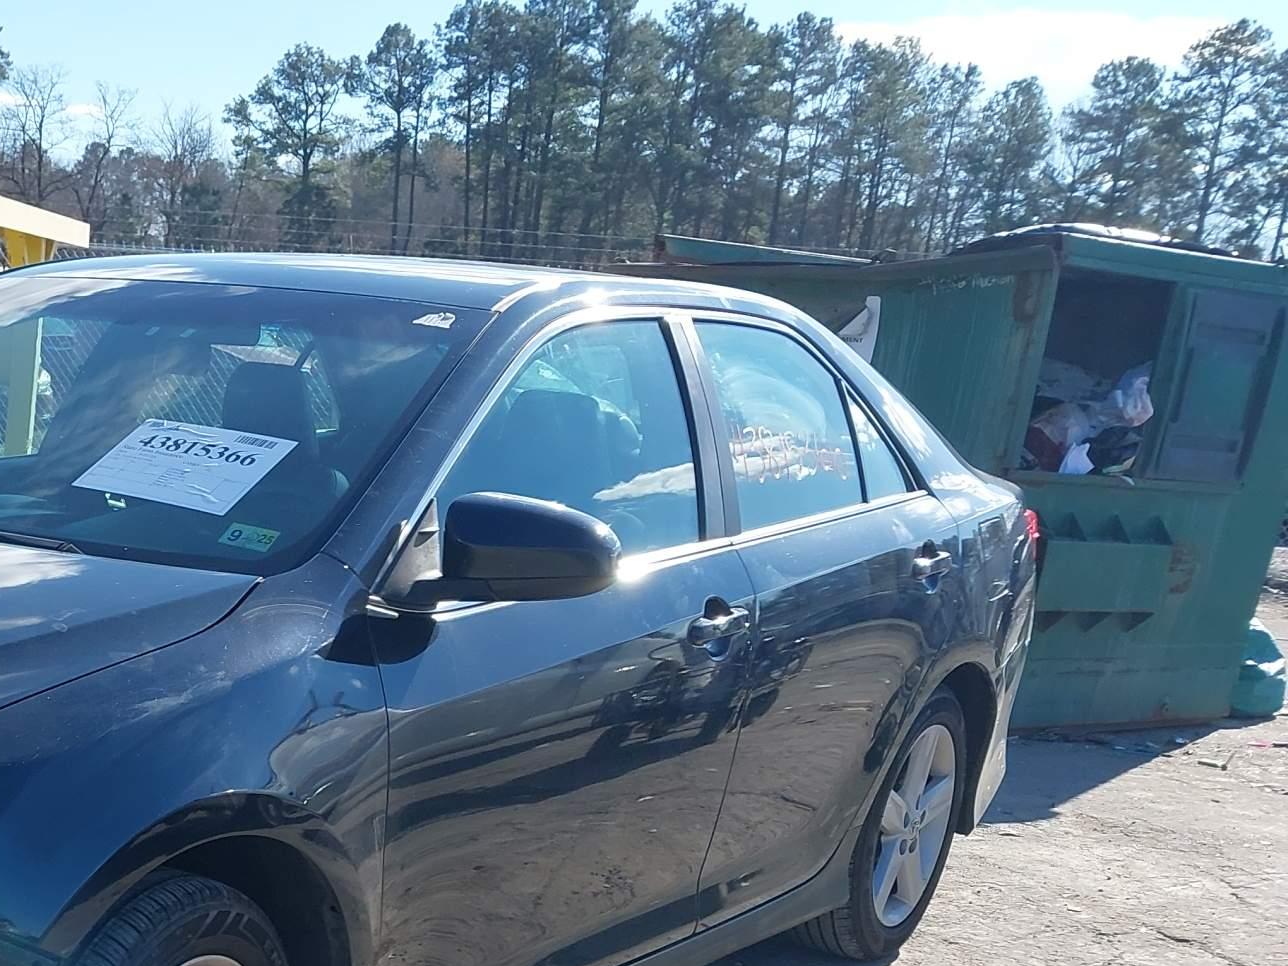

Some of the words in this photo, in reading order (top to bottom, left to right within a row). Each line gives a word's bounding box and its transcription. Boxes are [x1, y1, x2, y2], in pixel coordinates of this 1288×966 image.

[138, 434, 258, 467] 43815366
[227, 529, 244, 542] 9
[257, 534, 275, 545] 25
